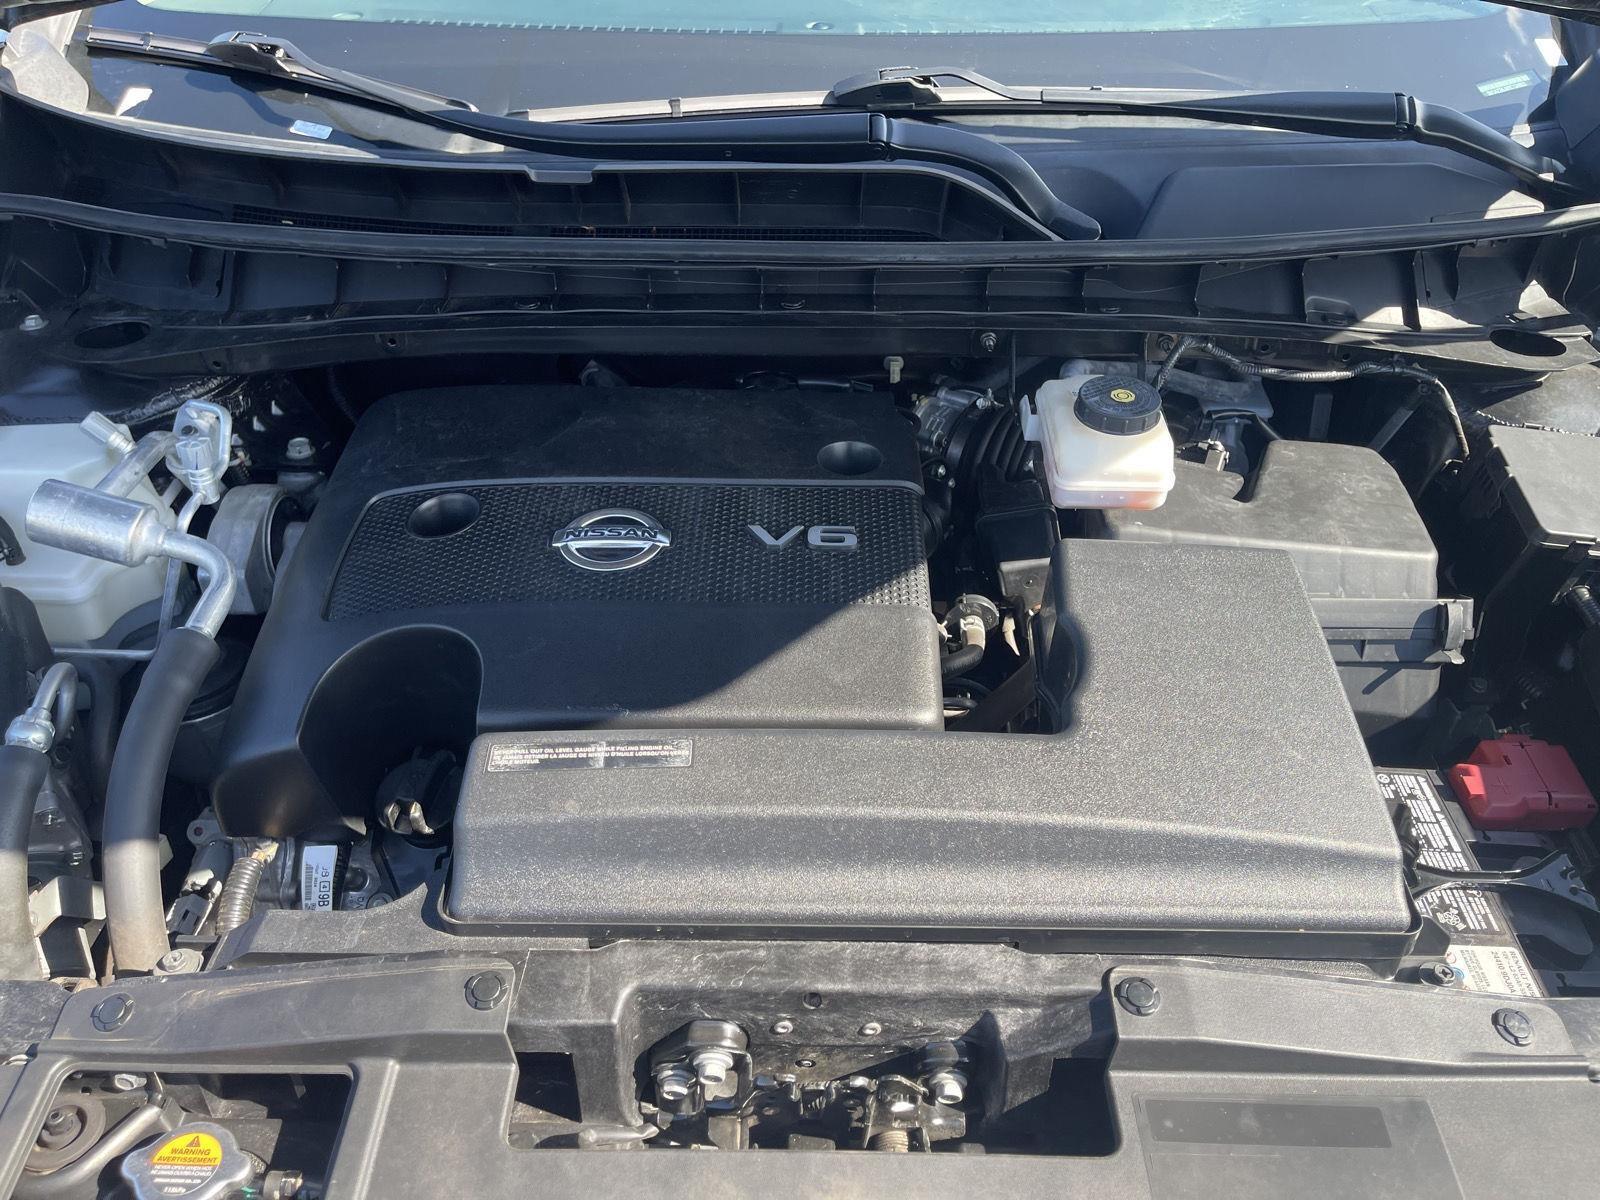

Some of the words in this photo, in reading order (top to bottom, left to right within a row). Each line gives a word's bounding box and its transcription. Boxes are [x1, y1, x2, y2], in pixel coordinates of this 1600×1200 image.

[565, 526, 659, 539] NISSAN
[748, 525, 858, 550] V6
[1509, 950, 1529, 981] RENAULT
[171, 1148, 211, 1156] WARNING
